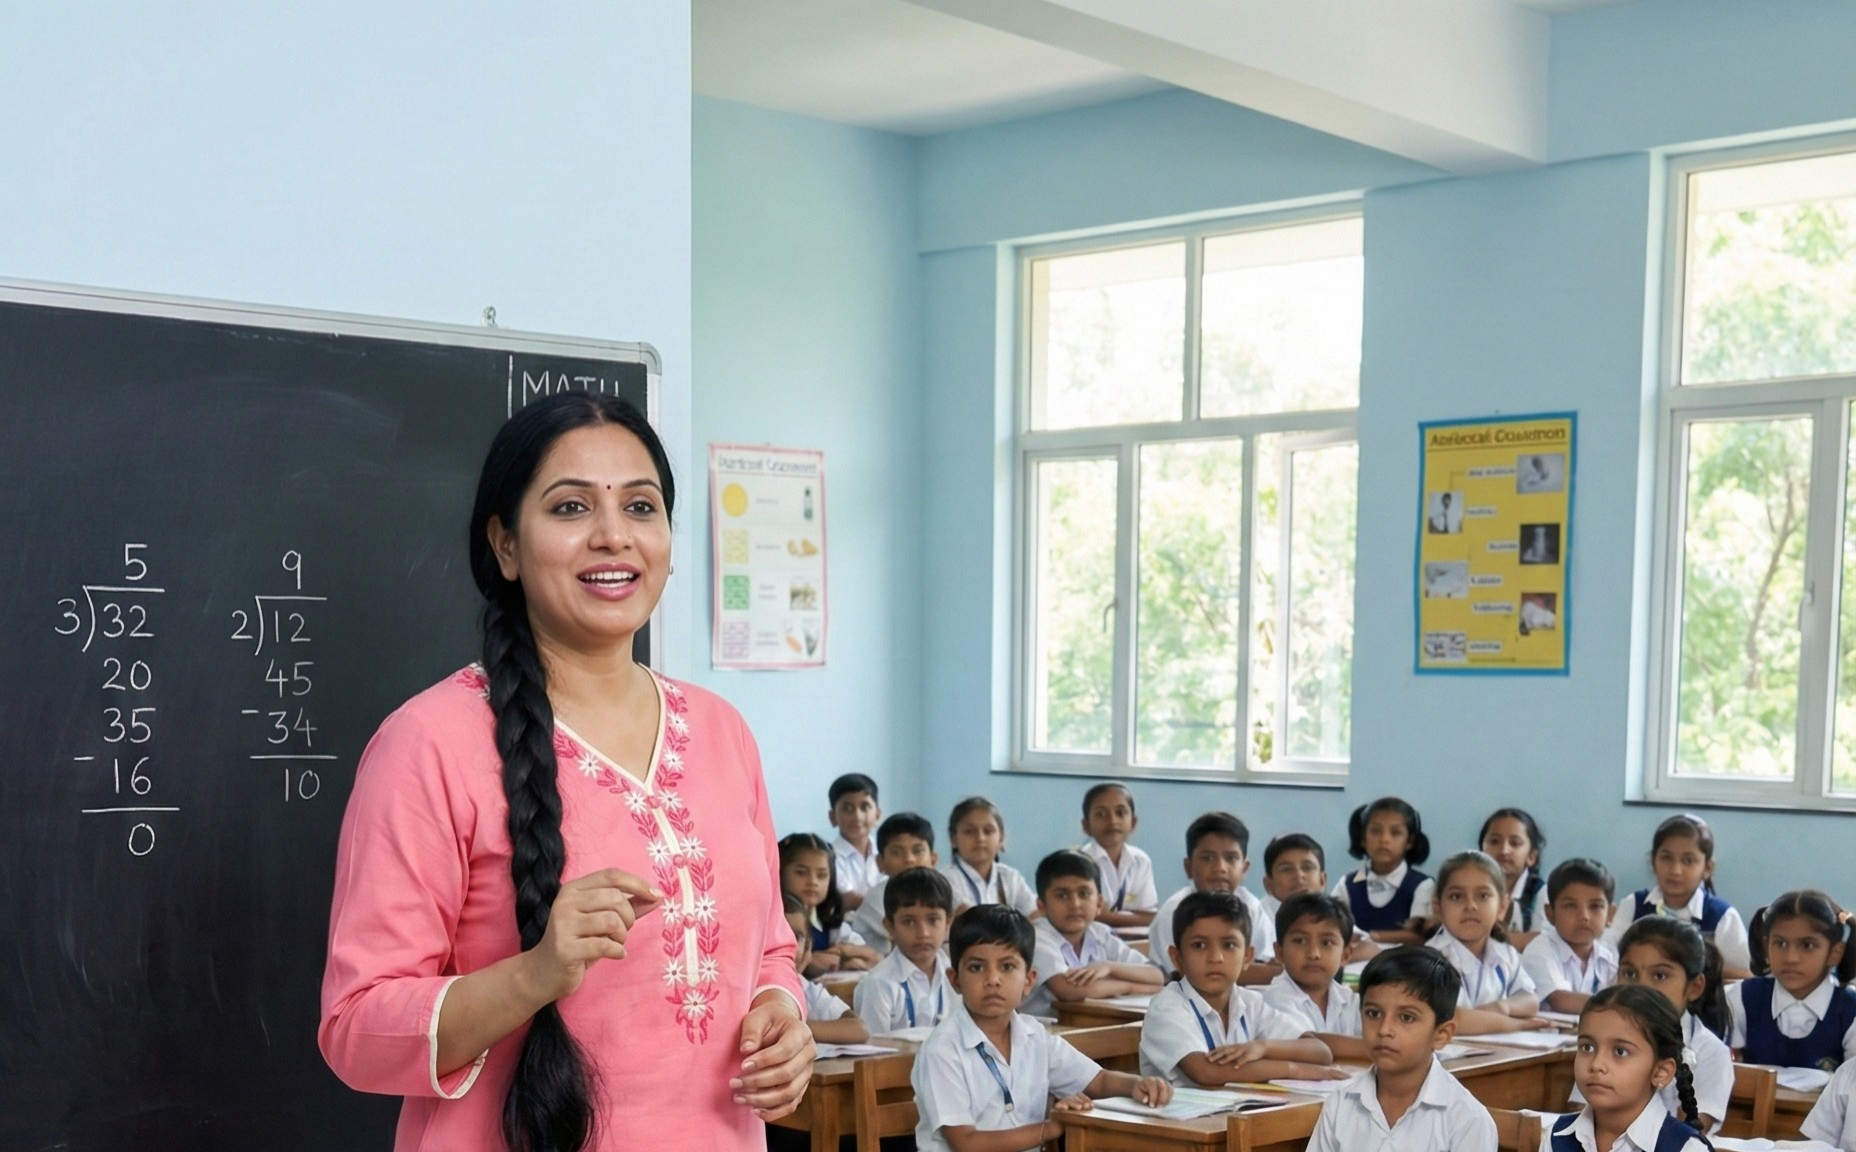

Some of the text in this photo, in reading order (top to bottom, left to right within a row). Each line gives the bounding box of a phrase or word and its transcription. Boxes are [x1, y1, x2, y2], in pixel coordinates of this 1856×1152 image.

[124, 543, 148, 581] 5
[281, 549, 302, 590] 9
[54, 598, 154, 638] 3 32
[230, 609, 312, 643] 2 12
[102, 657, 152, 691] 20
[264, 658, 315, 698] 45
[103, 707, 157, 744] 35
[285, 768, 321, 802] 10
[128, 822, 156, 856] 0
